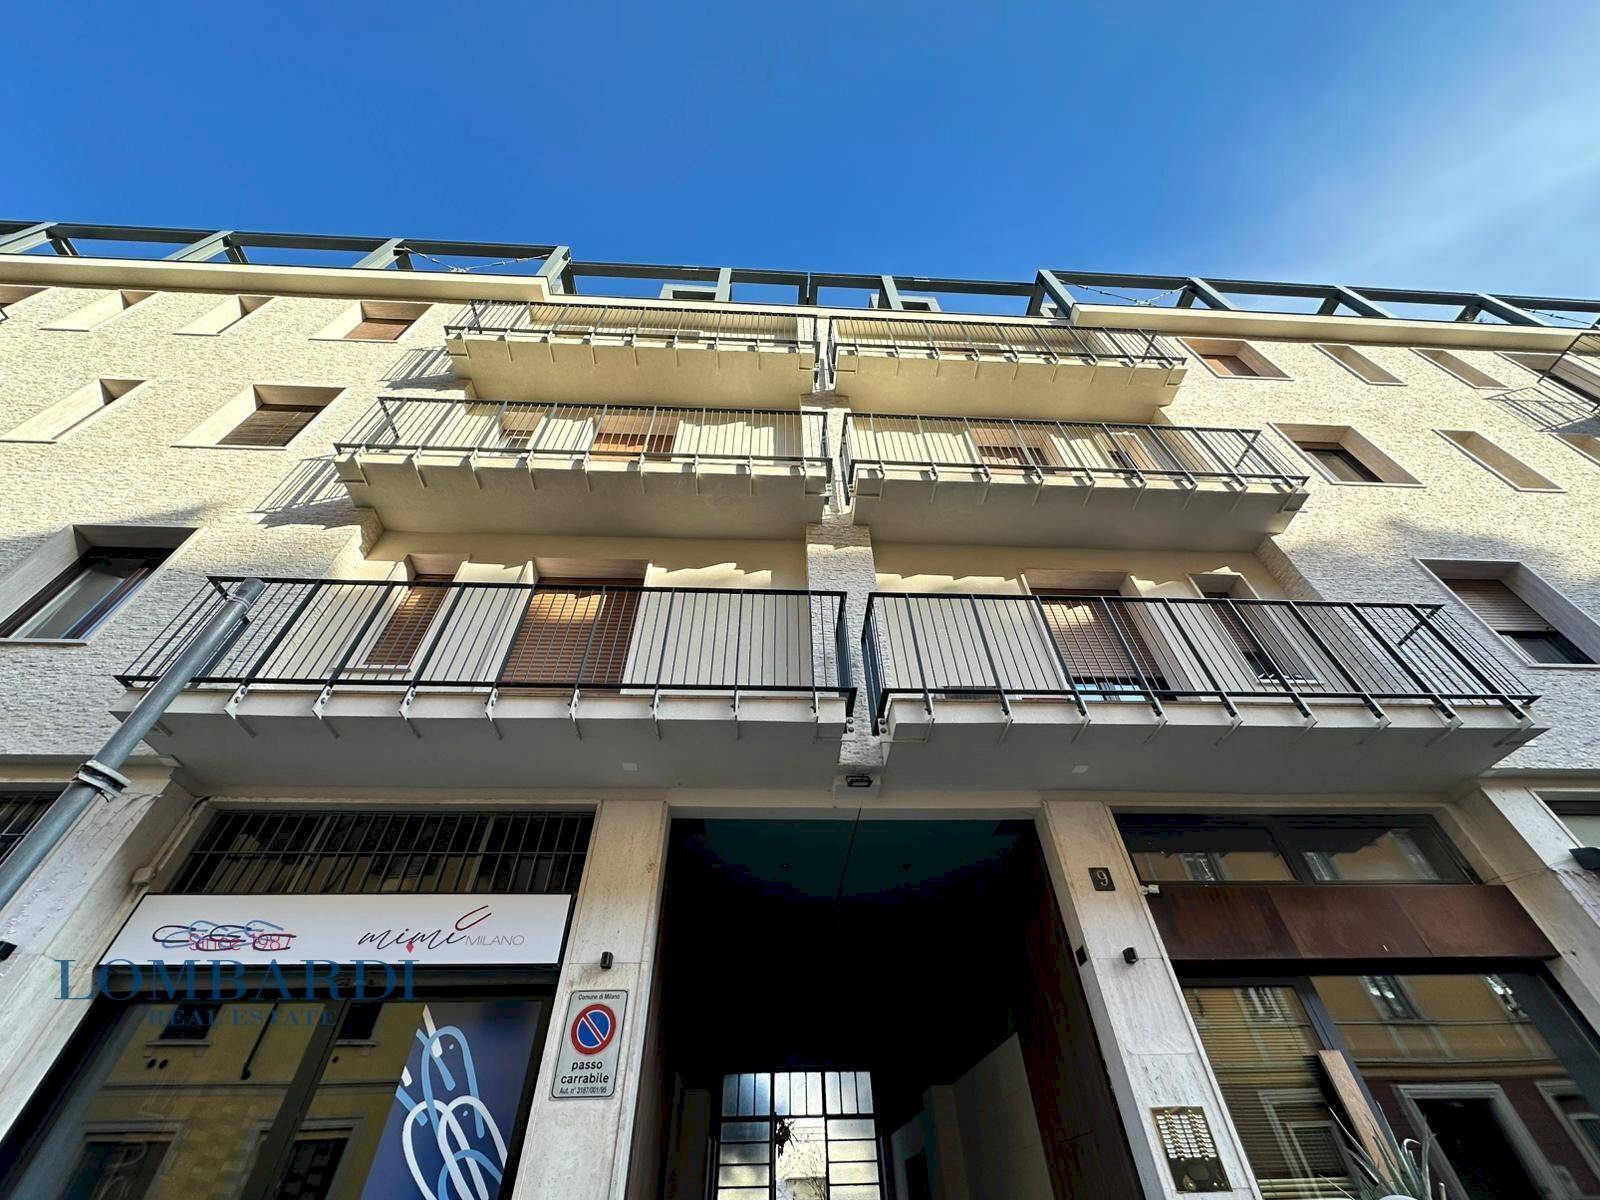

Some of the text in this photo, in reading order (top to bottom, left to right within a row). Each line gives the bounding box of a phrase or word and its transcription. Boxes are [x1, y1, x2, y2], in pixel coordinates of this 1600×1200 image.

[1097, 870, 1109, 887] 9
[465, 934, 525, 946] MILANO
[571, 1061, 603, 1071] passo
[560, 1073, 609, 1084] carrabile
